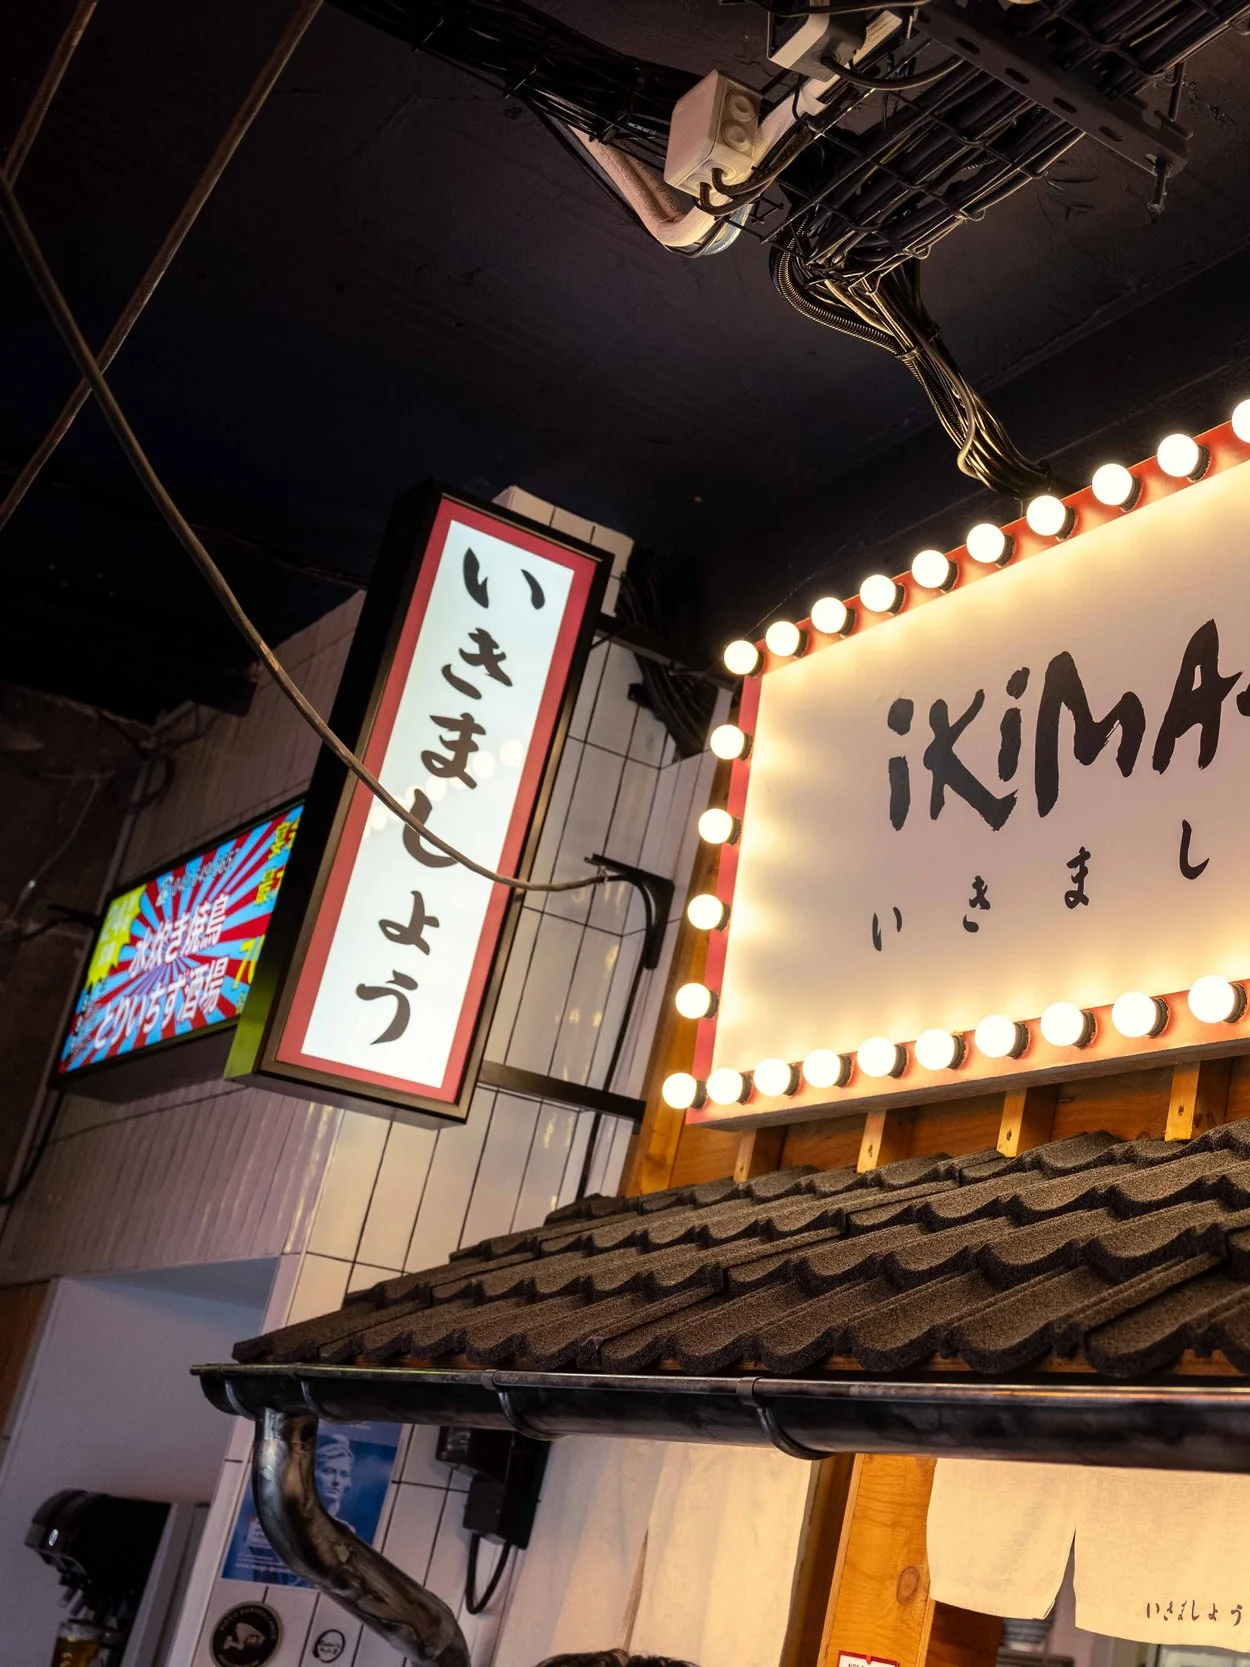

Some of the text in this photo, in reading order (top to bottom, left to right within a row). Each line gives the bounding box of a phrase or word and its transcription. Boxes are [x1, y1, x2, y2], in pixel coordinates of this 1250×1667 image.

[356, 547, 546, 1046] いきましょう
